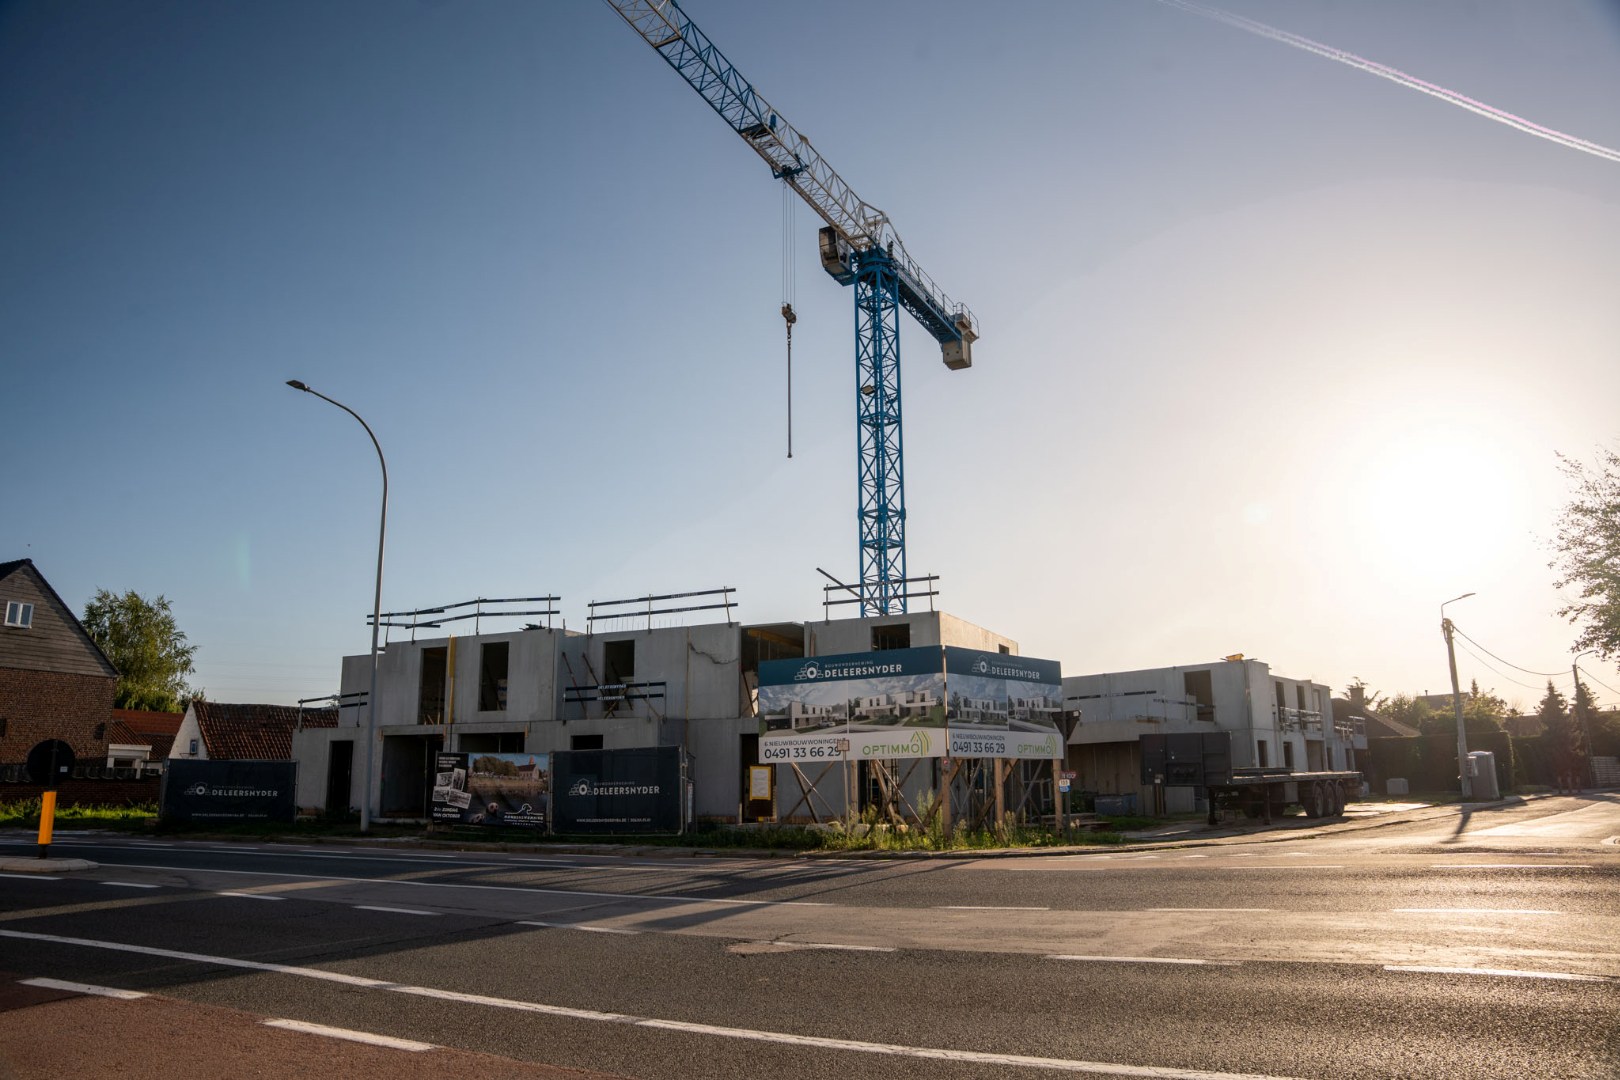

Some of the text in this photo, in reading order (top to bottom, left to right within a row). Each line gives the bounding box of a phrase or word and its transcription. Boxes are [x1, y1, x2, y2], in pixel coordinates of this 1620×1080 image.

[824, 664, 902, 678] DELEERSNYDER
[992, 666, 1040, 679] DELEERSNYDER
[764, 746, 841, 759] 0491 33 66 29
[862, 743, 920, 756] OPTIMMO
[952, 741, 1005, 753] 0491 33 66 29
[1017, 744, 1051, 755] OPTIMMO
[211, 789, 278, 797] DELEERSNYDER
[593, 785, 660, 796] DELEERSNYDER
